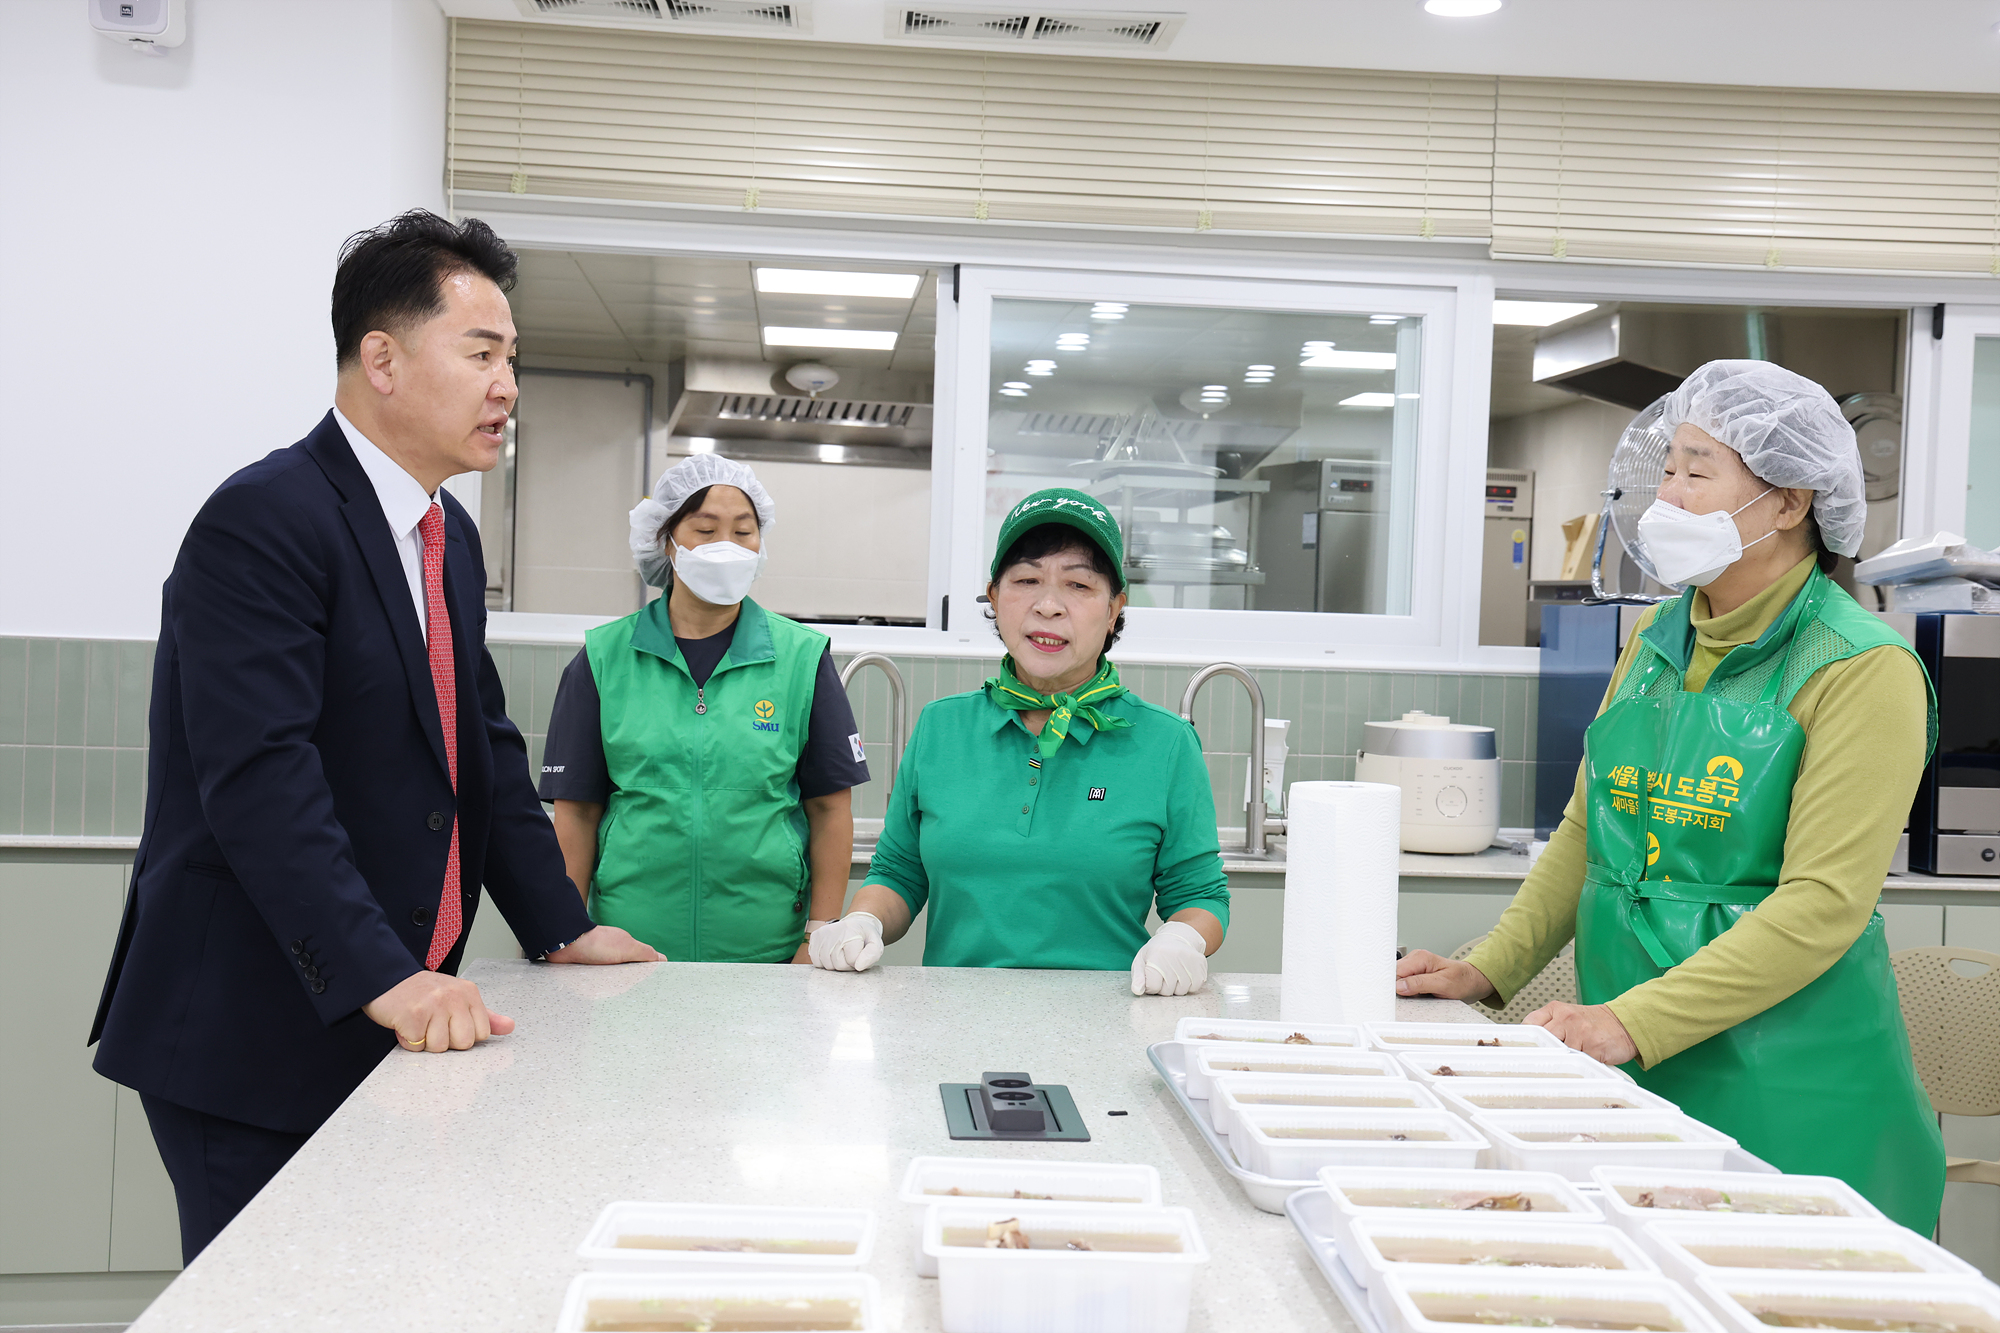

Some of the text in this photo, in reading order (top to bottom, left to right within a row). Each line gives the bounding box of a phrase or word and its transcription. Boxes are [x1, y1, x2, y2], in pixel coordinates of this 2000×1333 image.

[752, 720, 779, 732] SMU
[1674, 776, 1740, 808] 도봉구
[1651, 805, 1725, 832] 도봉구지회
